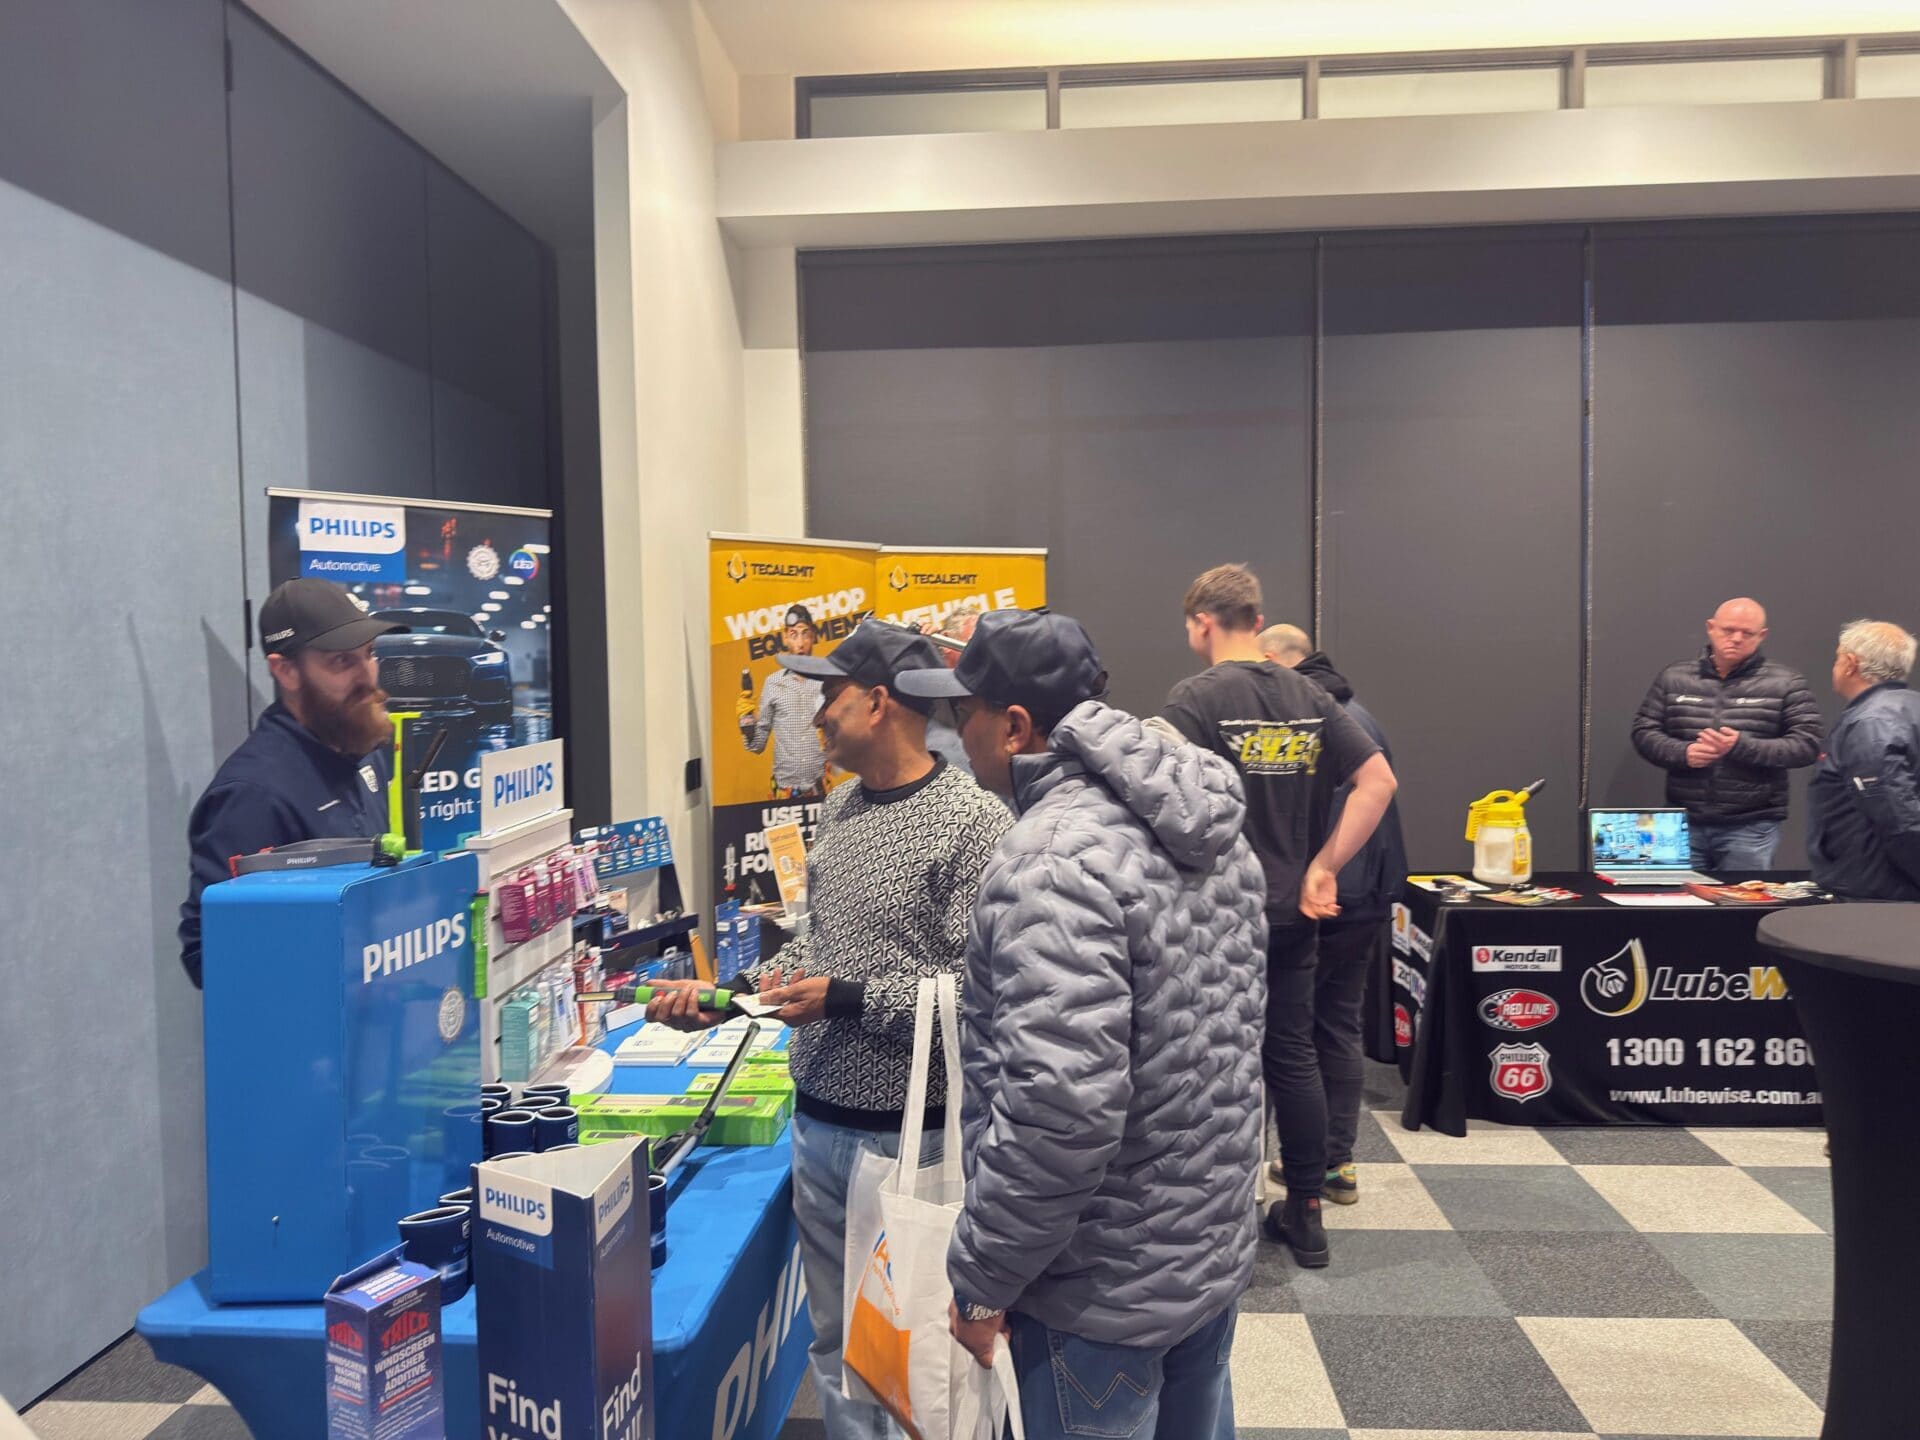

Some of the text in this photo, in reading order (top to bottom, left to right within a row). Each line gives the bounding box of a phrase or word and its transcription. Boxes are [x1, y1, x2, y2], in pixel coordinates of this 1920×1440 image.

[309, 517, 396, 539] PHILIPS
[308, 558, 382, 573] Automotive
[751, 563, 815, 578] TECALEMIT
[912, 573, 978, 585] TECALEMIT
[264, 628, 296, 643] PHILIPS
[494, 761, 553, 808] PHILIPS
[429, 797, 475, 821] right
[762, 804, 804, 829] USE
[286, 856, 318, 865] PHILIPS
[363, 912, 467, 984] PHILIPS
[1492, 949, 1557, 963] Kendall
[1502, 1003, 1551, 1015] RED LINE
[1500, 1053, 1541, 1063] PHILLIPS
[1606, 1037, 1685, 1066] 1300
[1696, 1037, 1756, 1066] 162
[1502, 1067, 1538, 1088] 66
[485, 1187, 547, 1221] PHILIPS
[598, 1175, 631, 1225] PHILIPS
[486, 1227, 537, 1253] Automotive
[392, 1289, 419, 1308] CAUTION
[381, 1311, 430, 1350] TRICO
[374, 1332, 436, 1374] WINDSCREEN
[385, 1350, 426, 1380] WASHER
[384, 1361, 428, 1394] ADDITIVE
[487, 1372, 562, 1440] Find
[602, 1350, 641, 1440] Find
